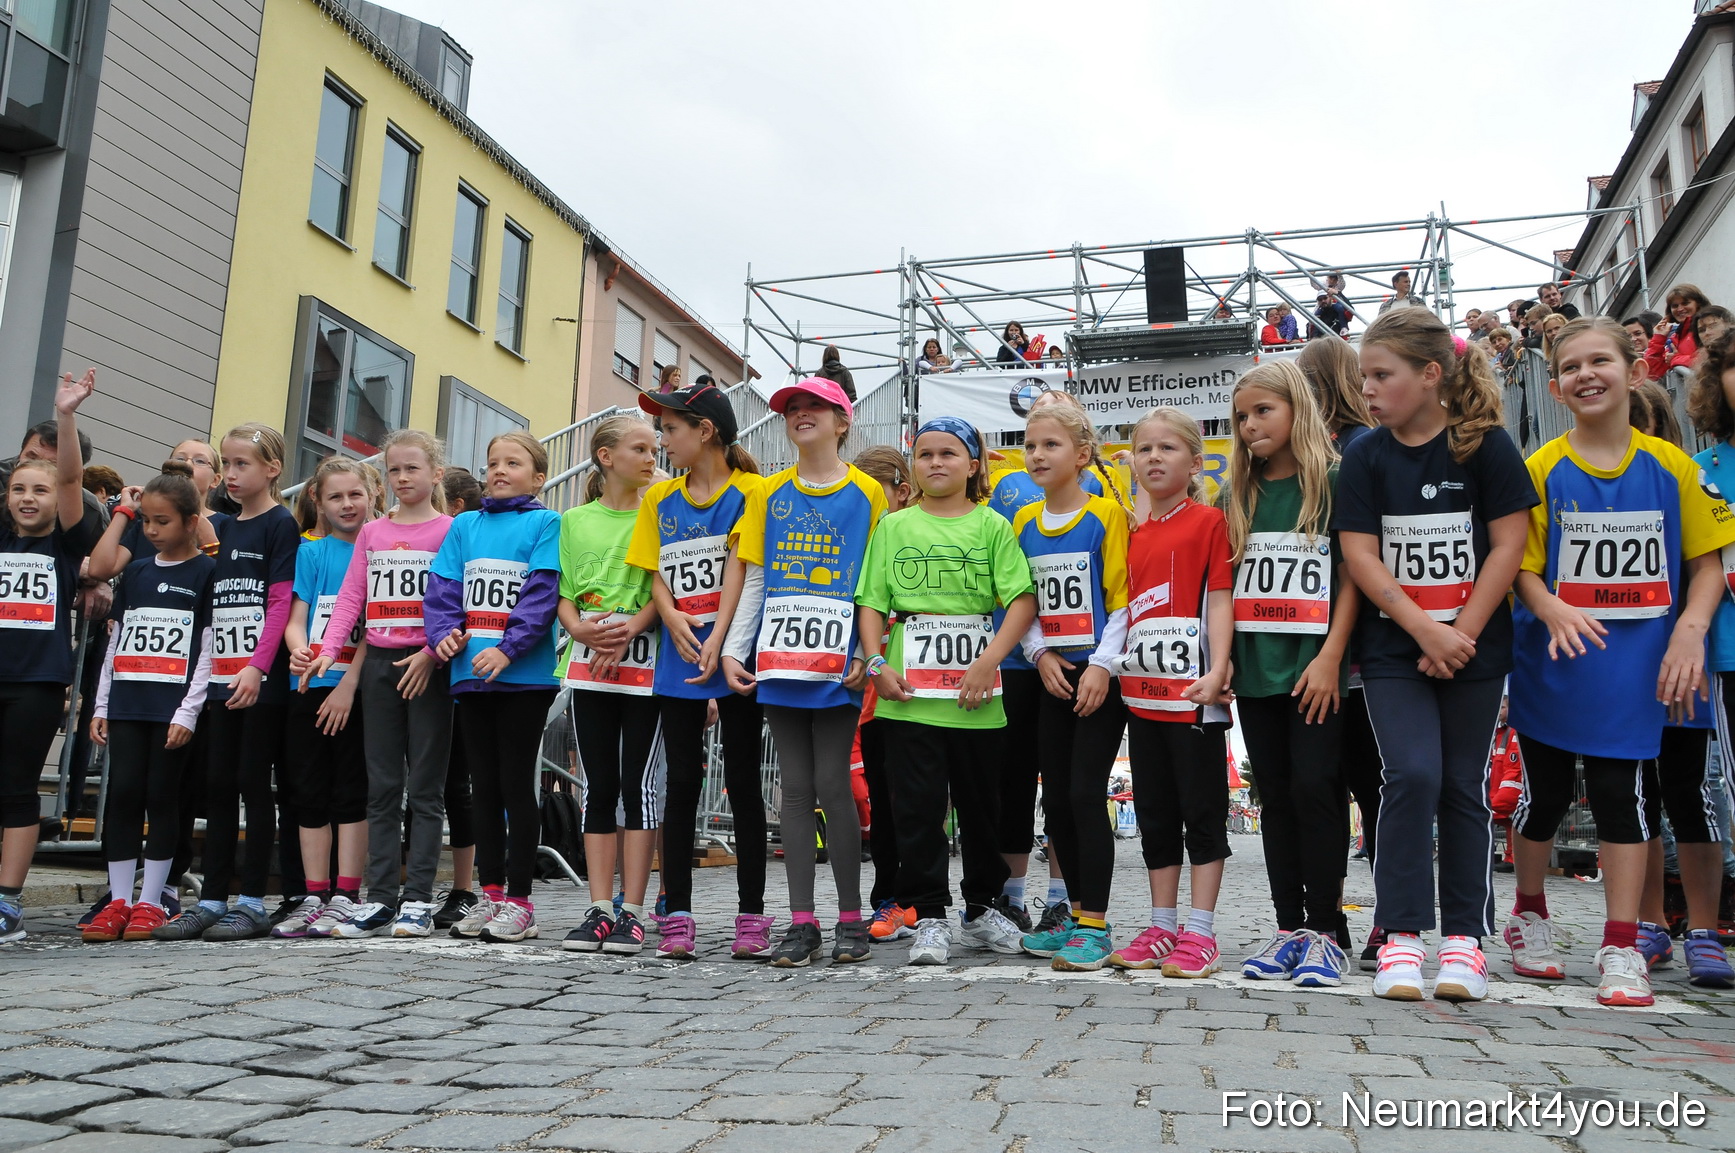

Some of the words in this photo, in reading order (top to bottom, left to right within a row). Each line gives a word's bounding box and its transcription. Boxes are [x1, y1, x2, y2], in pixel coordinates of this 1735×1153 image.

[1063, 376, 1122, 395] BMW
[1128, 369, 1242, 393] EfficientD
[1078, 400, 1123, 413] eniger
[1126, 393, 1204, 409] Verbrauch.
[1208, 391, 1231, 404] Me
[1383, 526, 1406, 536] PARTL
[1409, 524, 1461, 536] Neumarkt
[1563, 523, 1598, 533] PARTL
[1602, 522, 1653, 533] Neumarkt
[682, 544, 722, 557] Neumarkt
[1264, 542, 1314, 554] Neumarkt
[4, 560, 43, 569] Neumarkt
[388, 558, 427, 566] Neumarkt
[822, 557, 839, 565] 2014
[1390, 540, 1469, 580] 7555
[1570, 538, 1660, 578] 7020
[478, 566, 517, 577] Neumarkt
[664, 556, 727, 595] 7537
[1244, 557, 1322, 595] 7076
[465, 578, 522, 610] 7065
[1595, 589, 1641, 603] Maria
[379, 605, 420, 616] Theresa
[685, 600, 717, 611] Selina
[764, 605, 791, 614] PARTL
[793, 604, 837, 615] Neumarkt
[1253, 603, 1296, 621] Svenja
[141, 615, 178, 624] Neumarkt
[218, 614, 251, 623] Neumarkt
[466, 614, 505, 628] Samina
[906, 621, 937, 632] PARTL
[939, 620, 981, 631] Neumarkt
[1138, 627, 1182, 637] Neumarkt
[769, 617, 843, 649] 7560
[121, 625, 184, 655] 7552
[914, 633, 988, 665] 7004
[942, 673, 960, 687] Eva
[1141, 681, 1168, 697] Paula
